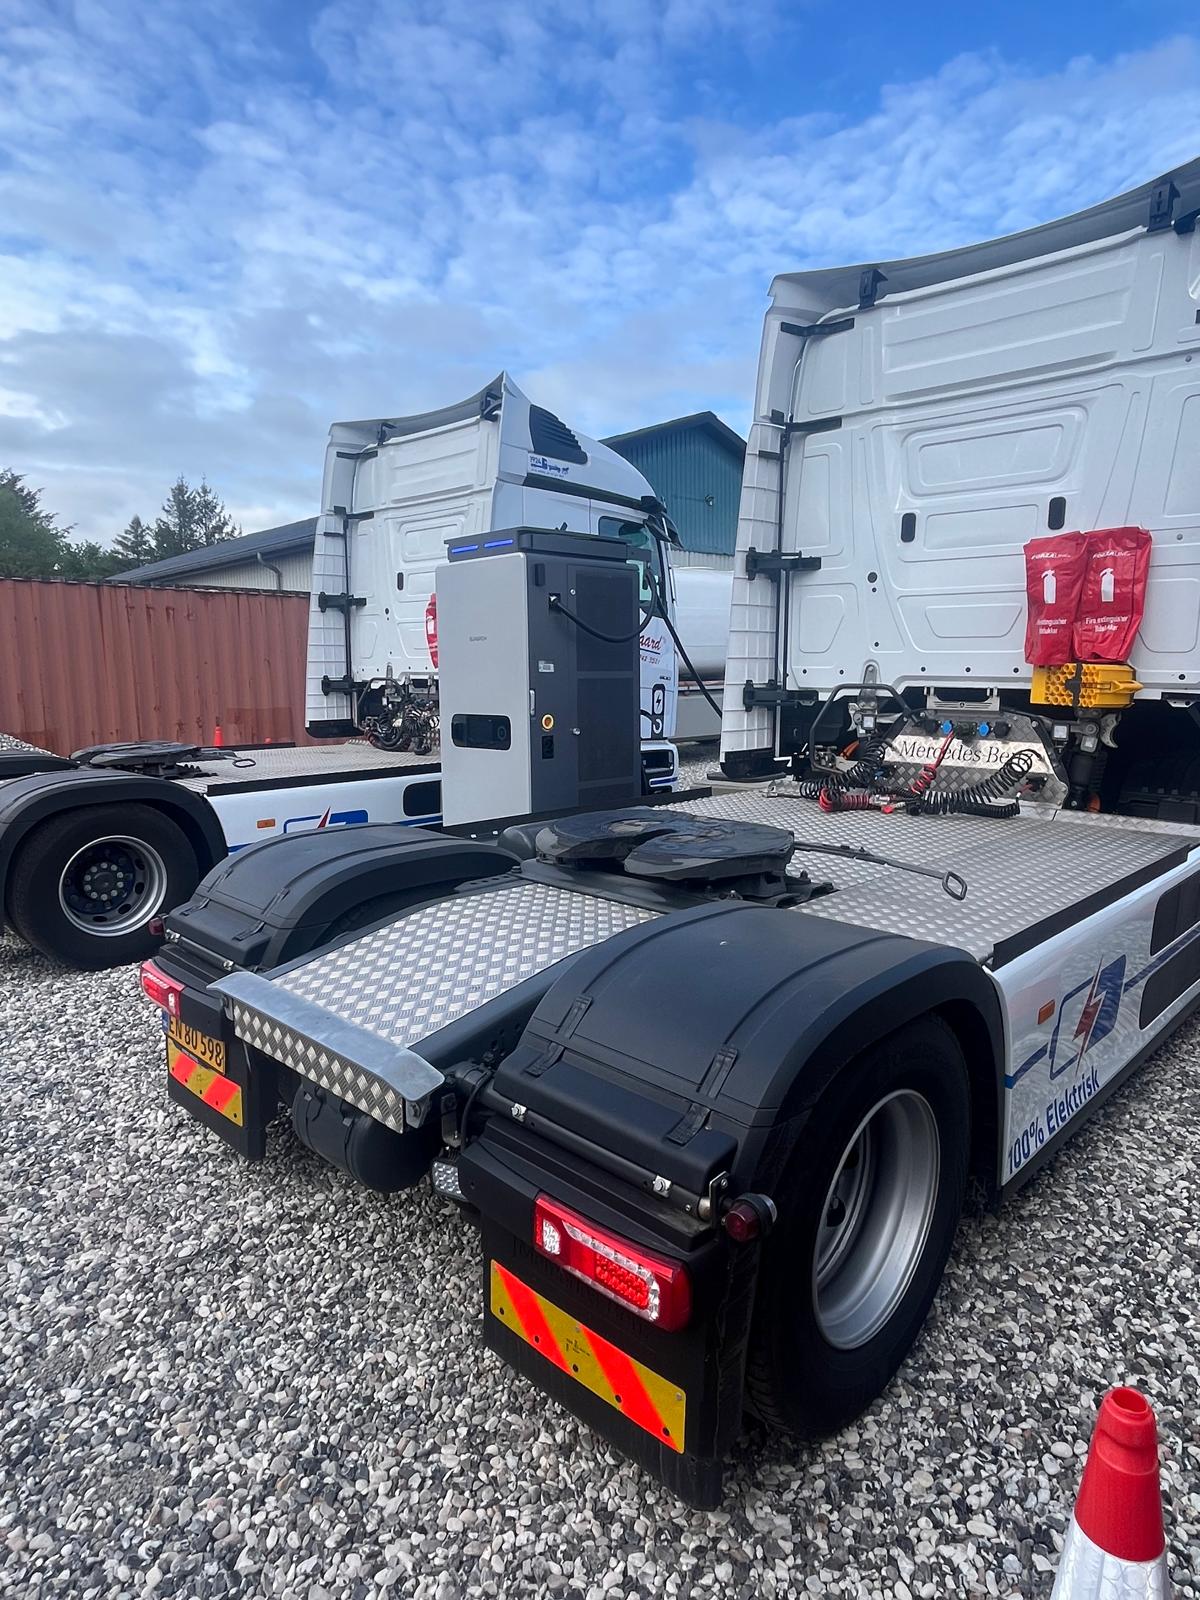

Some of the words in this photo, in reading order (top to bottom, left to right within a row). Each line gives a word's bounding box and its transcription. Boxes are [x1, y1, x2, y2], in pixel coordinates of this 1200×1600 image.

[639, 635, 662, 650] aard
[200, 1034, 224, 1067] 598
[1007, 1116, 1045, 1175] 100%
[1046, 1065, 1100, 1136] Elektrisk
